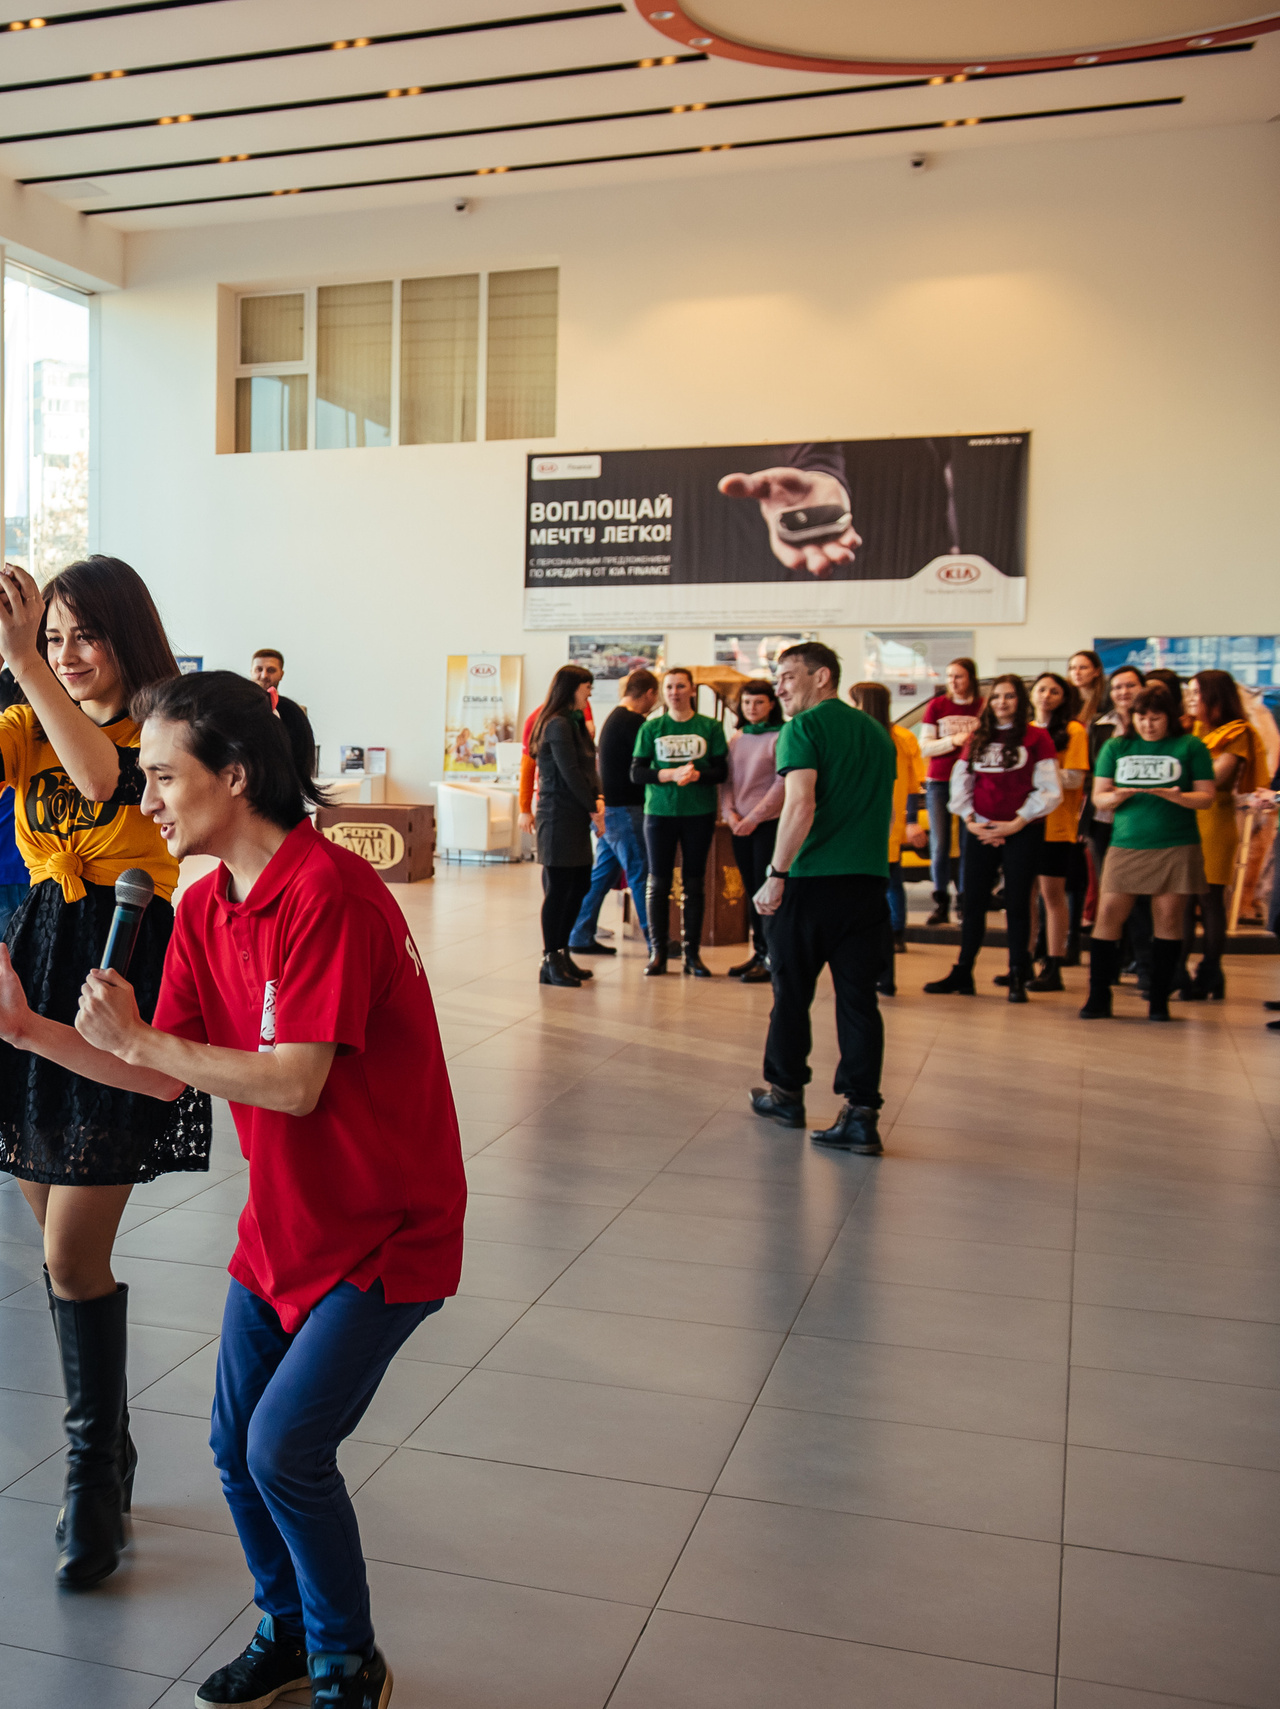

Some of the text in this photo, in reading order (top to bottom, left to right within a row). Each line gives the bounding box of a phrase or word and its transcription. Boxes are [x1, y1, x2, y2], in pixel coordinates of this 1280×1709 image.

[529, 493, 673, 523] ВОПЛОЩАЙ
[529, 524, 673, 546] МЕЧТУ ЛЕГКО!
[529, 568, 544, 579] ПО
[545, 567, 592, 580] КРЕДИТУ
[592, 566, 607, 577] ОТ
[343, 827, 382, 838] FORT
